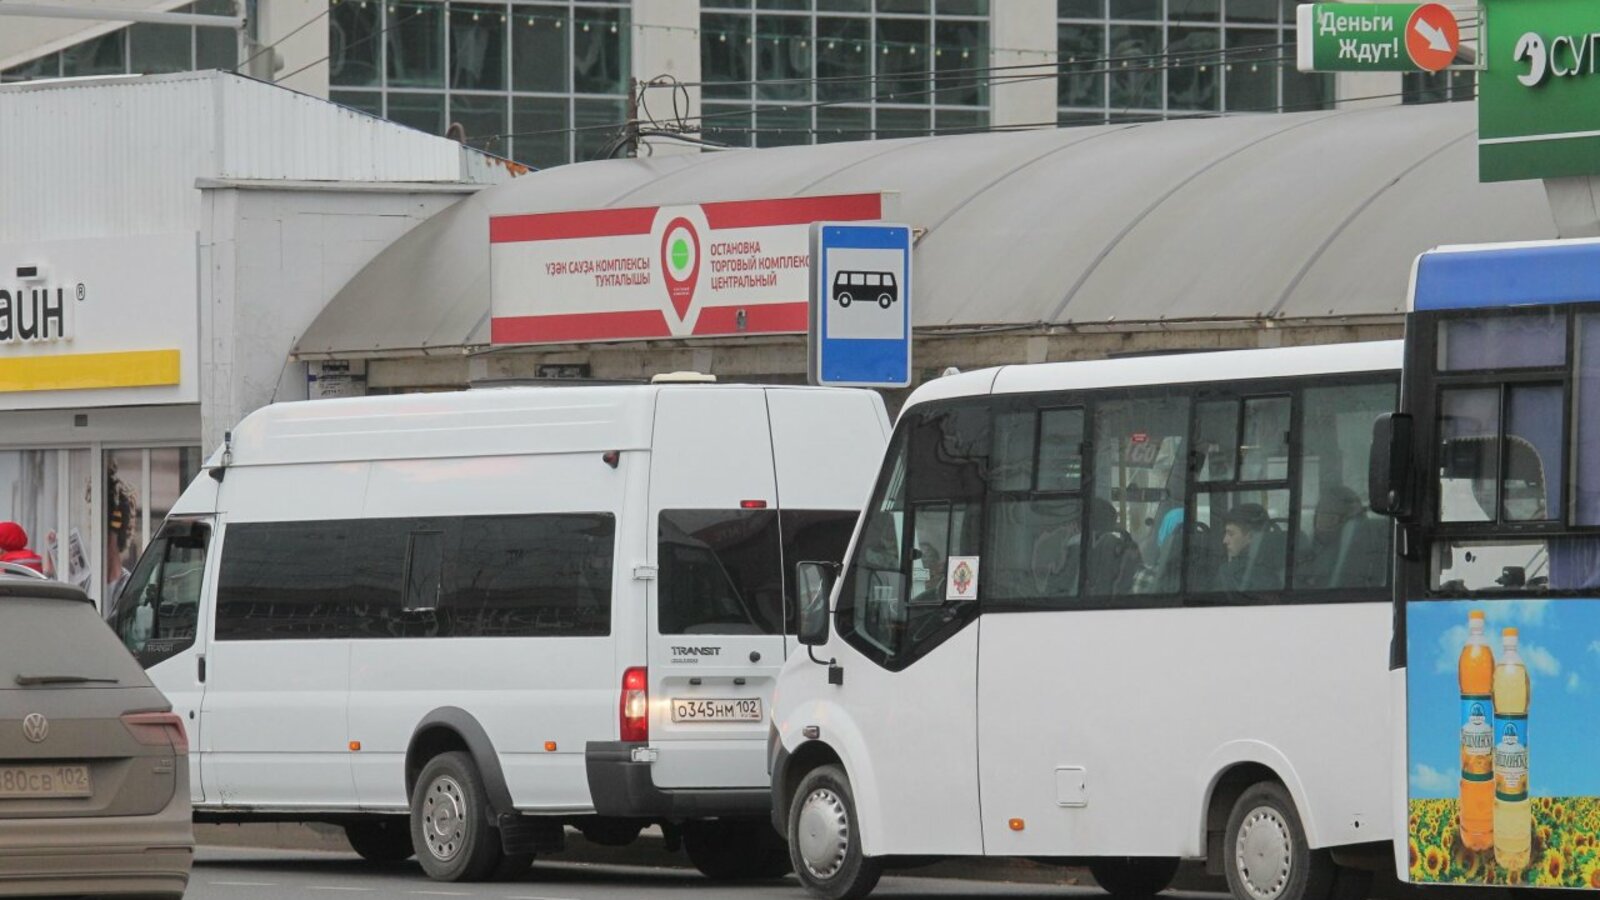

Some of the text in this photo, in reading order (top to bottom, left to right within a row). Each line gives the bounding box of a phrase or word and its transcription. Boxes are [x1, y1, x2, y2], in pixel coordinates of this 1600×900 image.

[1320, 11, 1393, 36] Деньги
[1338, 37, 1398, 63] Ждут!
[710, 241, 760, 256] ОСТАНОВКА
[595, 257, 650, 272] КОМПЛЕКСЫ
[710, 255, 757, 273] ТОРГОВЫЙ
[710, 271, 777, 292] ЦЕНТРАЛЬНЫЙ
[671, 646, 721, 656] TRANSIT
[736, 701, 756, 713] 102
[0, 767, 84, 792] 80СВ 102
